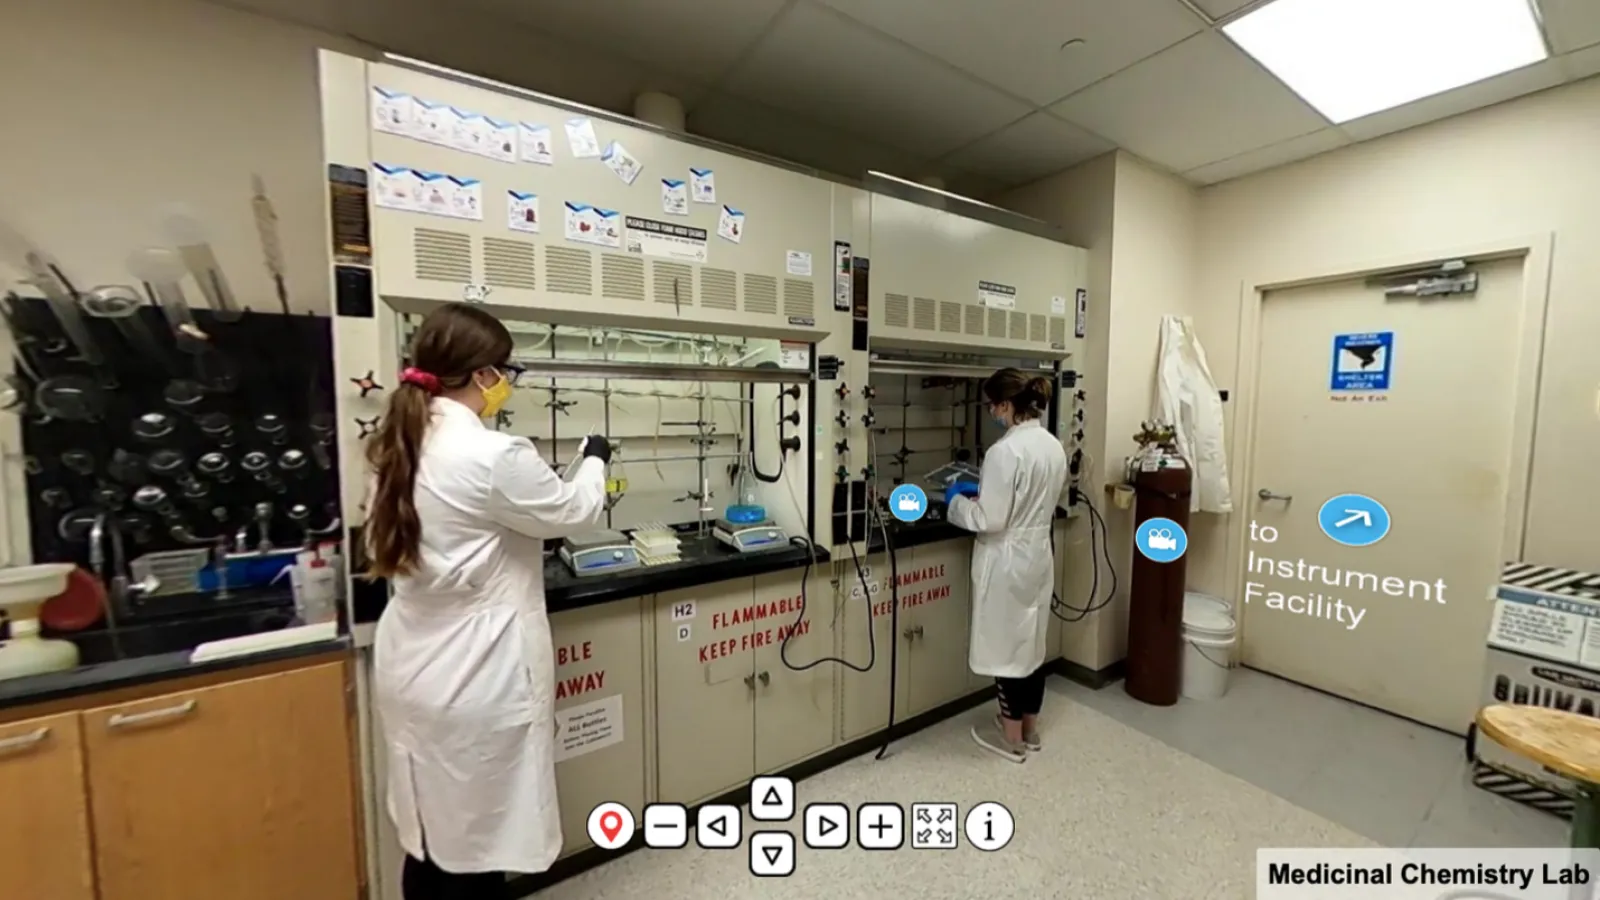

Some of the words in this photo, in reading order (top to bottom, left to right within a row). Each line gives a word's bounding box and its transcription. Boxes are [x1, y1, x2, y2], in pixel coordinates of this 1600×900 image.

[674, 603, 693, 618] H2
[712, 595, 803, 630] FLAMMABLE
[873, 599, 898, 618] KEE
[902, 591, 924, 610] FIRE
[927, 584, 951, 602] AWAY
[679, 627, 689, 639] D
[699, 638, 736, 663] KEEP
[742, 629, 772, 651] FIRE
[777, 619, 811, 642] AWAY
[555, 669, 605, 700] AWAY
